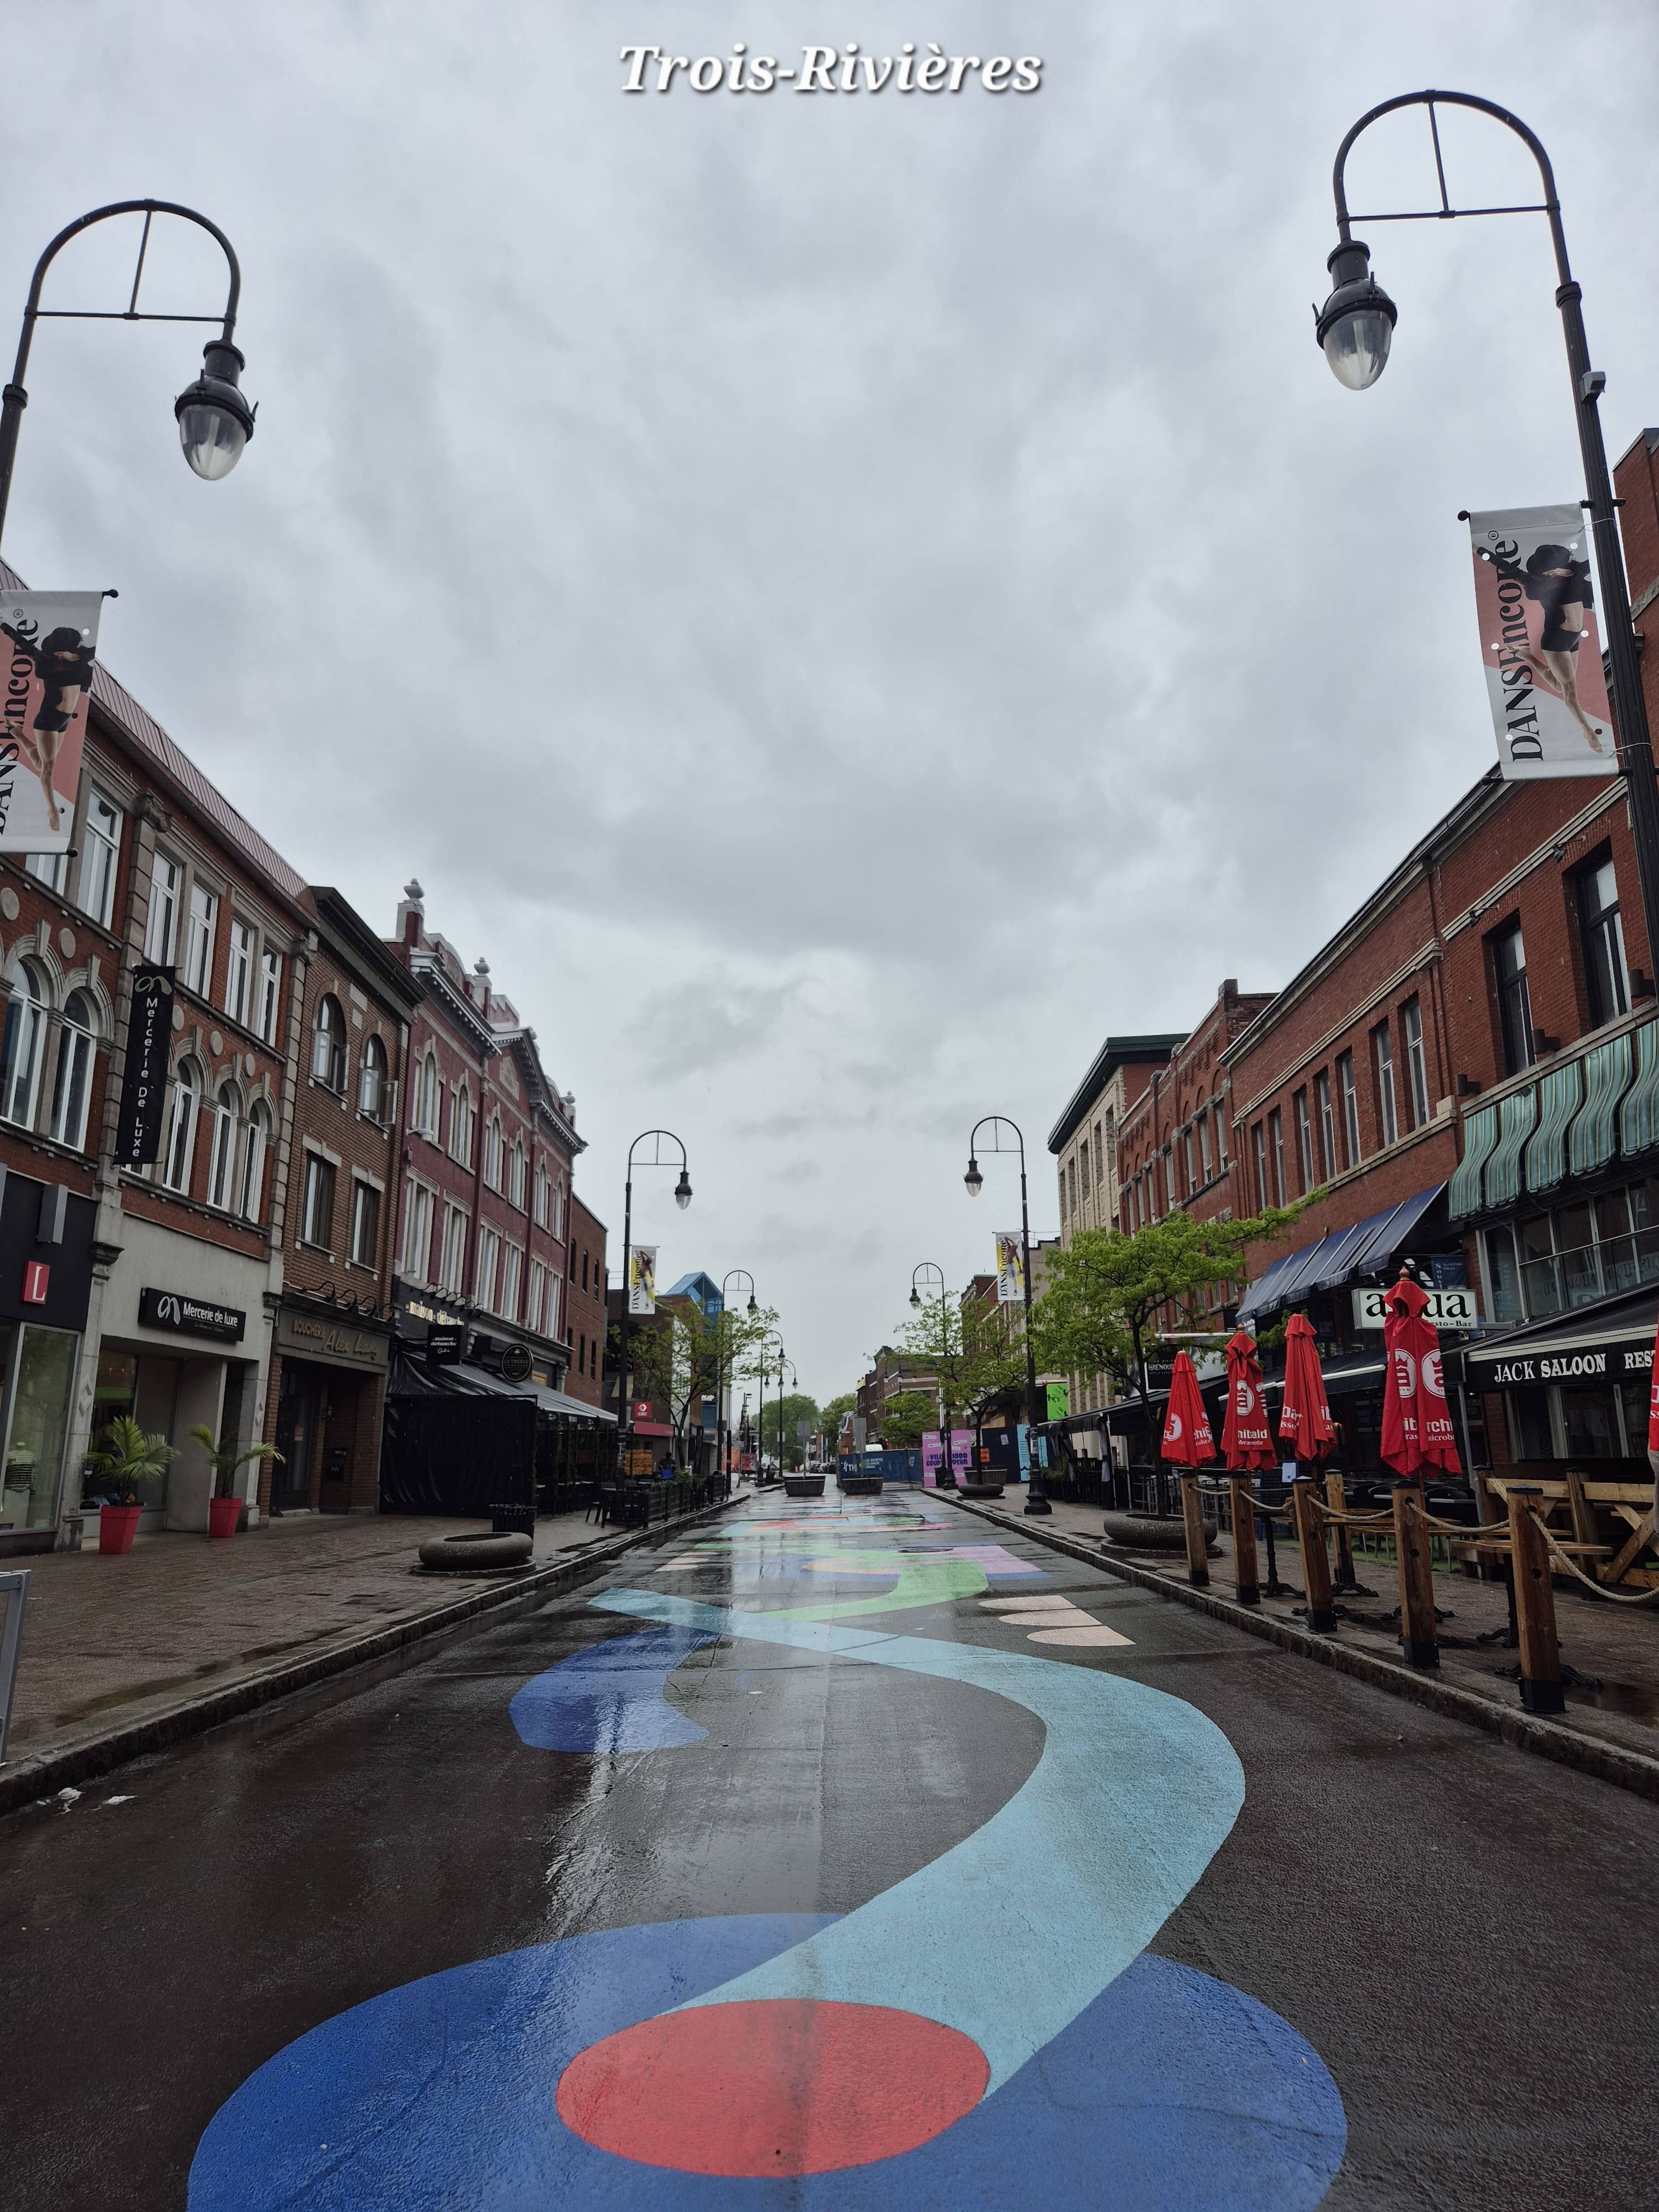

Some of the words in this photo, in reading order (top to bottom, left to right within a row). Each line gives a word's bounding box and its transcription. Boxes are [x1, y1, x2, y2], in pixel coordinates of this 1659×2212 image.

[140, 997, 159, 1078] Mercerie
[138, 1086, 148, 1108] De
[132, 1116, 143, 1157] Luxe
[183, 1301, 213, 1321] Mercerie
[215, 1310, 223, 1323] de
[223, 1312, 238, 1327] luxe
[1365, 1293, 1471, 1318] aua
[1494, 1360, 1536, 1383] JACK
[1540, 1353, 1606, 1379] SALOON
